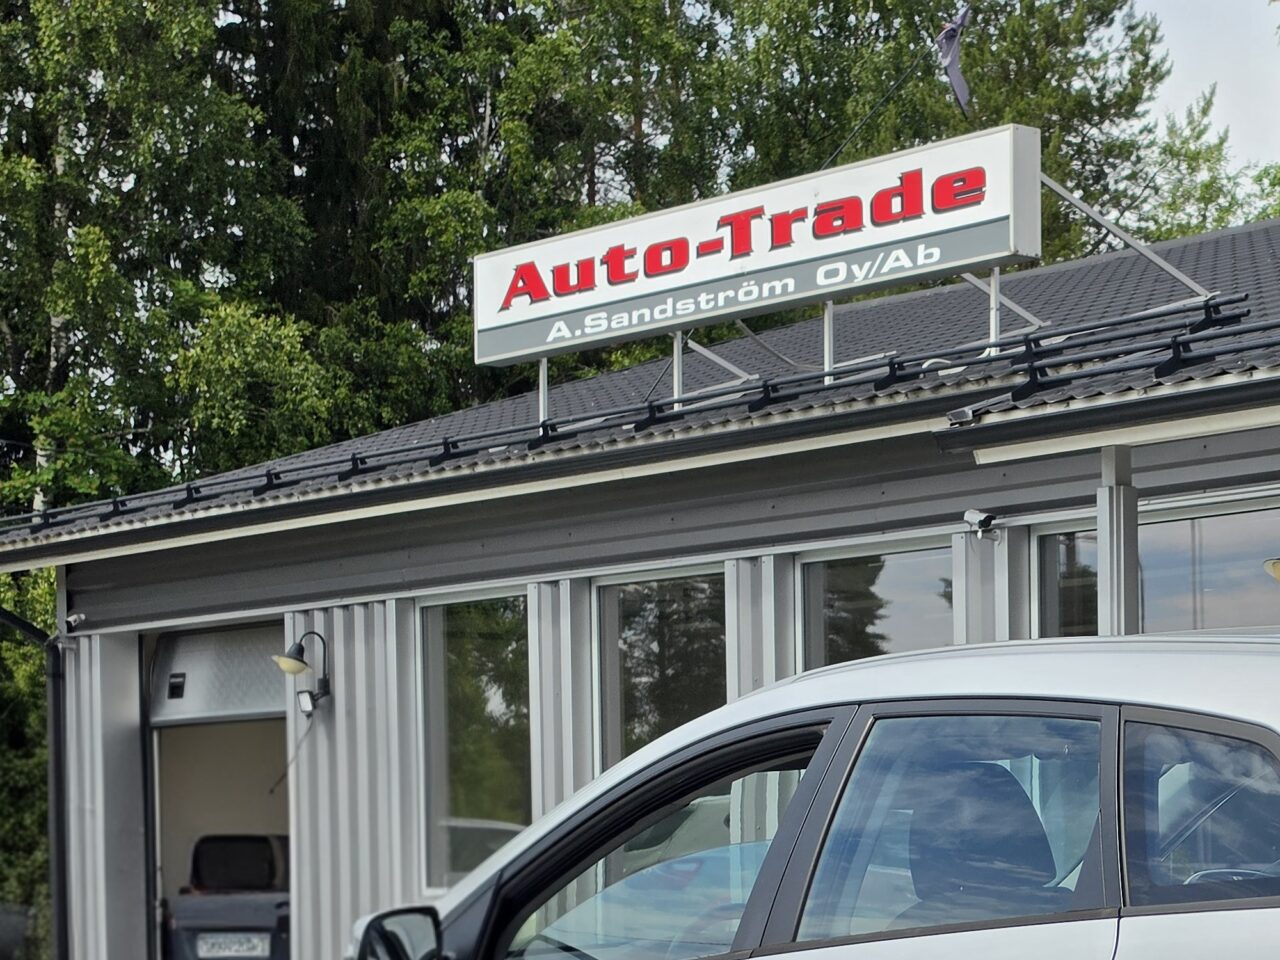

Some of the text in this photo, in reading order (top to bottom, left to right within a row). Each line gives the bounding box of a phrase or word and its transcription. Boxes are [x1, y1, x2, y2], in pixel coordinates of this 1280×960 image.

[497, 165, 987, 313] Auto-Trade
[545, 242, 942, 344] A.Sandström Oy/Ab
